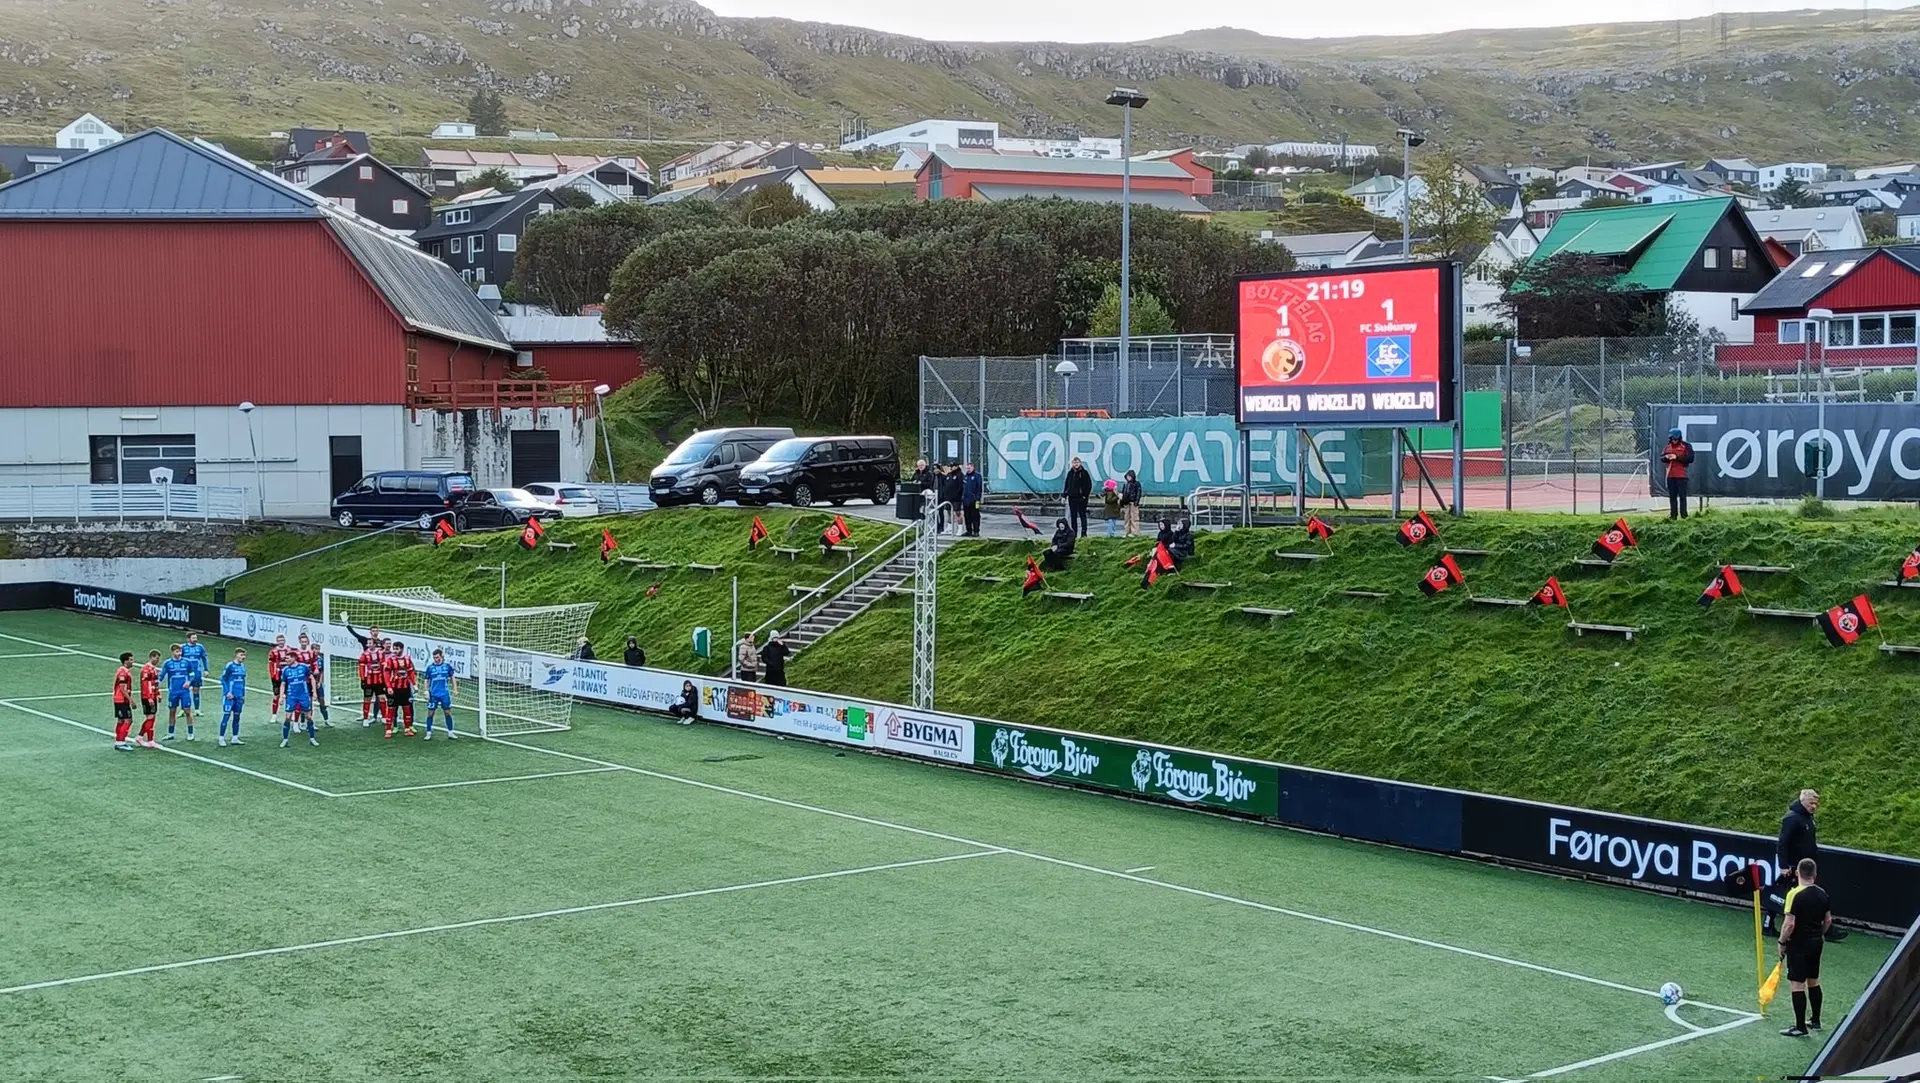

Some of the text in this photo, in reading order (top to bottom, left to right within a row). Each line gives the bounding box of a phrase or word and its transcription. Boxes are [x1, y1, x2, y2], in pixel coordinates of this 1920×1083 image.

[960, 137, 993, 146] WAAG
[1306, 279, 1365, 300] 21:19
[1276, 305, 1288, 327] 1
[1381, 298, 1394, 321] 1
[1276, 327, 1290, 337] HB
[1360, 323, 1372, 333] FC
[1245, 391, 1434, 412] WENZEL.FO WENZEL.FO WENZEL.FO
[572, 666, 608, 682] ATLANTIC
[572, 680, 608, 695] AIRWAYS
[903, 721, 958, 746] BYGMA
[1061, 736, 1100, 777] Bjór
[1211, 760, 1256, 802] Bjór
[1549, 817, 1679, 879] Føroya
